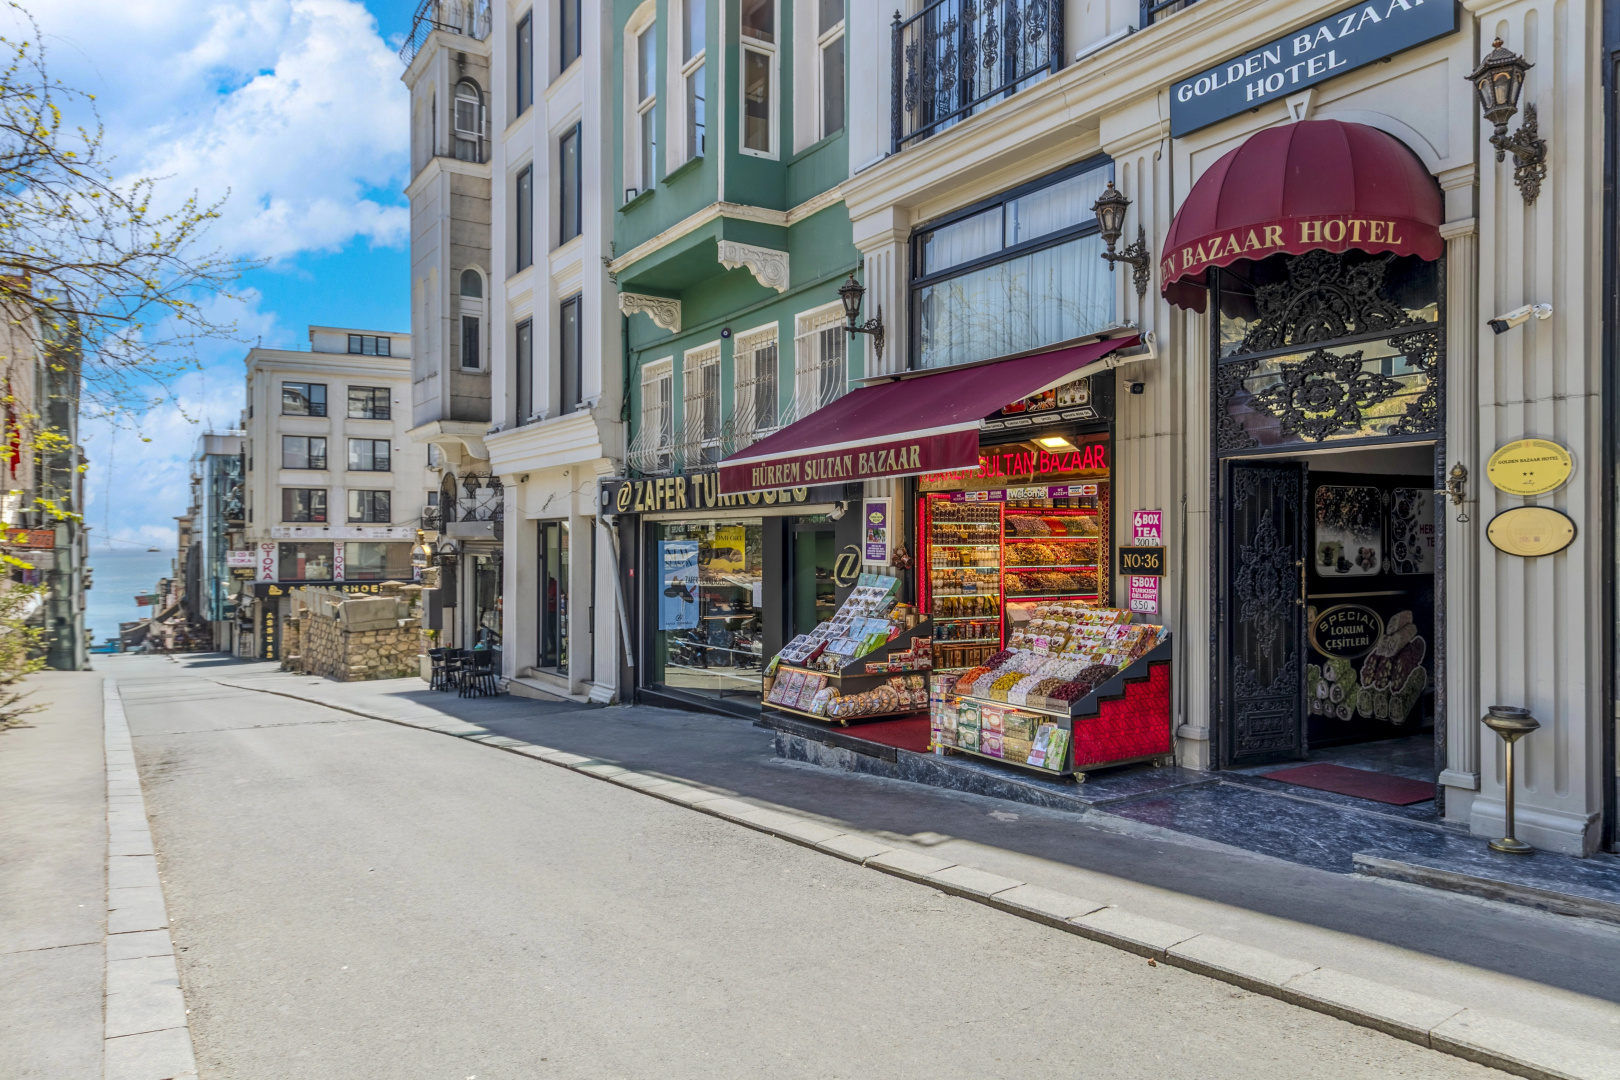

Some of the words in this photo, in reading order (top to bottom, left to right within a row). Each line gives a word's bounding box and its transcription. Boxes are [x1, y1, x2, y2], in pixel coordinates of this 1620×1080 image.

[1177, 46, 1281, 102] GOLDEN
[1293, 0, 1425, 56] BAZAA
[1246, 50, 1347, 101] HOTEL
[1182, 225, 1285, 270] BAZAAR
[1299, 219, 1402, 245] HOTEL
[752, 461, 800, 487] HÜRREM
[804, 454, 853, 481] SULTAN
[858, 445, 921, 475] BAZAAR
[977, 452, 1034, 478] SULTAN
[1040, 444, 1107, 474] BAZAAR
[634, 476, 687, 511] ZAFER
[1010, 488, 1045, 499] Welcome
[1136, 527, 1158, 537] TEA
[1419, 524, 1435, 535] HER
[712, 534, 743, 542] OMFORT
[1123, 553, 1159, 568] NO:36
[1132, 600, 1148, 610] 350
[1319, 611, 1376, 632] SPECIAL
[1331, 625, 1364, 636] LOKUM
[1325, 635, 1369, 650] ÇEŞİTLERİ
